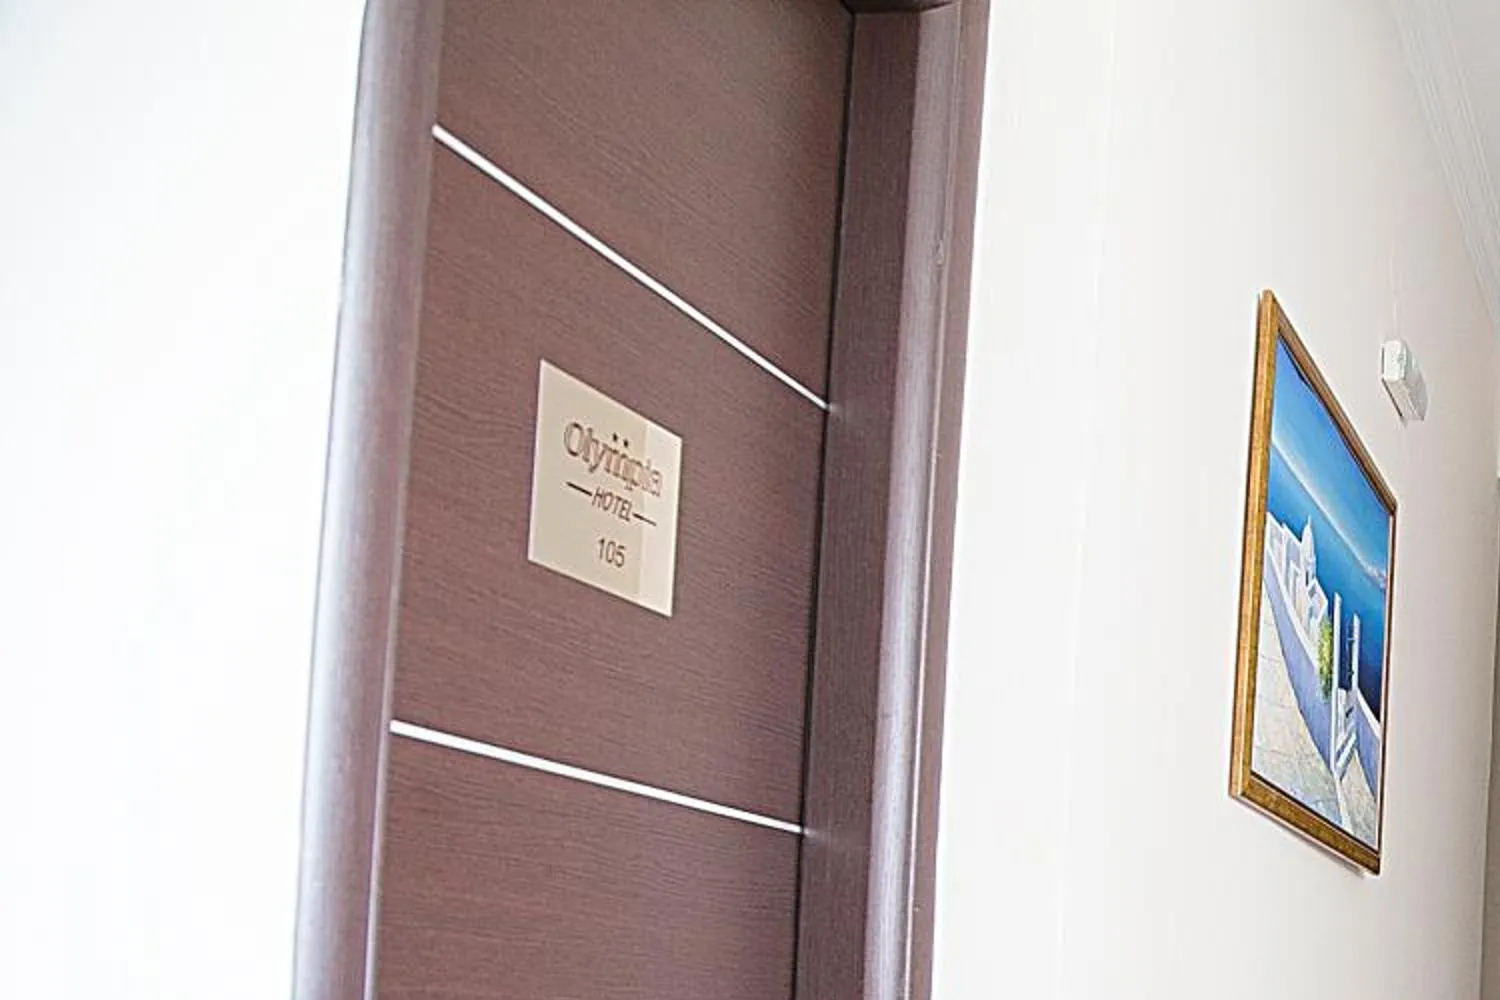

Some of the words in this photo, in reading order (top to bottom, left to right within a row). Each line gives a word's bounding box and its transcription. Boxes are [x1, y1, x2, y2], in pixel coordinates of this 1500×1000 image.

[563, 421, 663, 497] Olympia
[591, 487, 634, 522] HOTEL
[597, 537, 626, 568] 105
